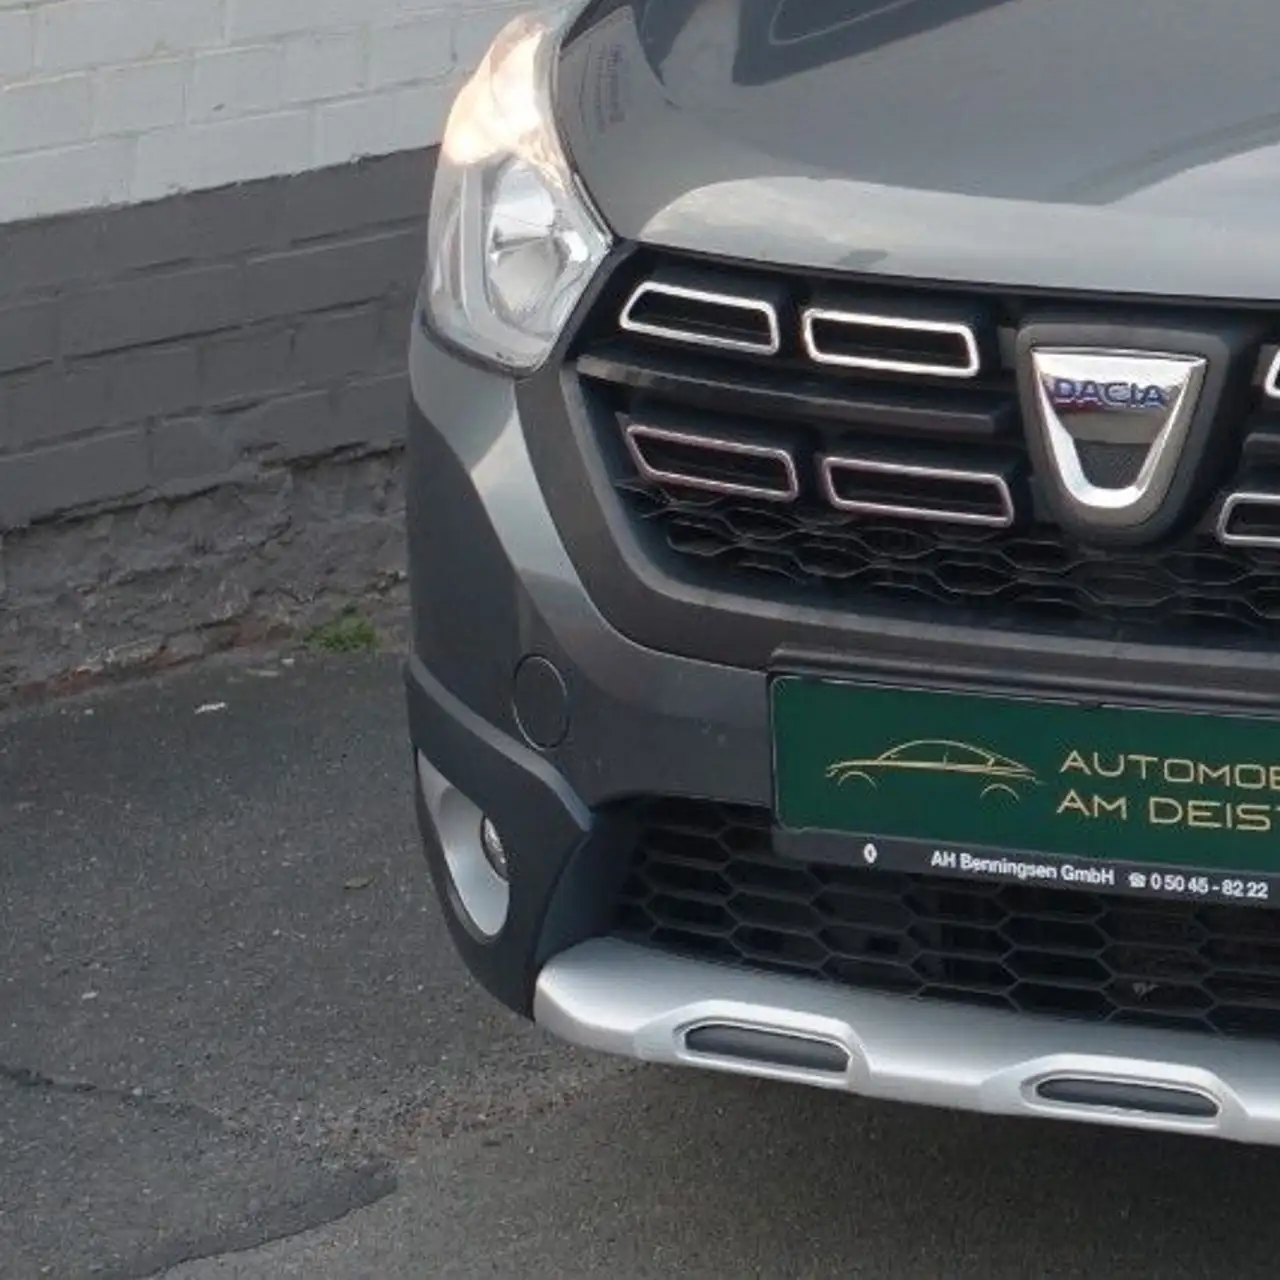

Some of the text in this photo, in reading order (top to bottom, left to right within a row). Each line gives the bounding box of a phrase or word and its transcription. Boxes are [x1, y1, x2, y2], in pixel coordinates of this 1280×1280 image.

[1050, 376, 1166, 410] DACIA
[1056, 787, 1128, 821] AM
[930, 849, 956, 868] AH
[959, 853, 1058, 881] Benningsen
[1061, 864, 1115, 886] GmbH
